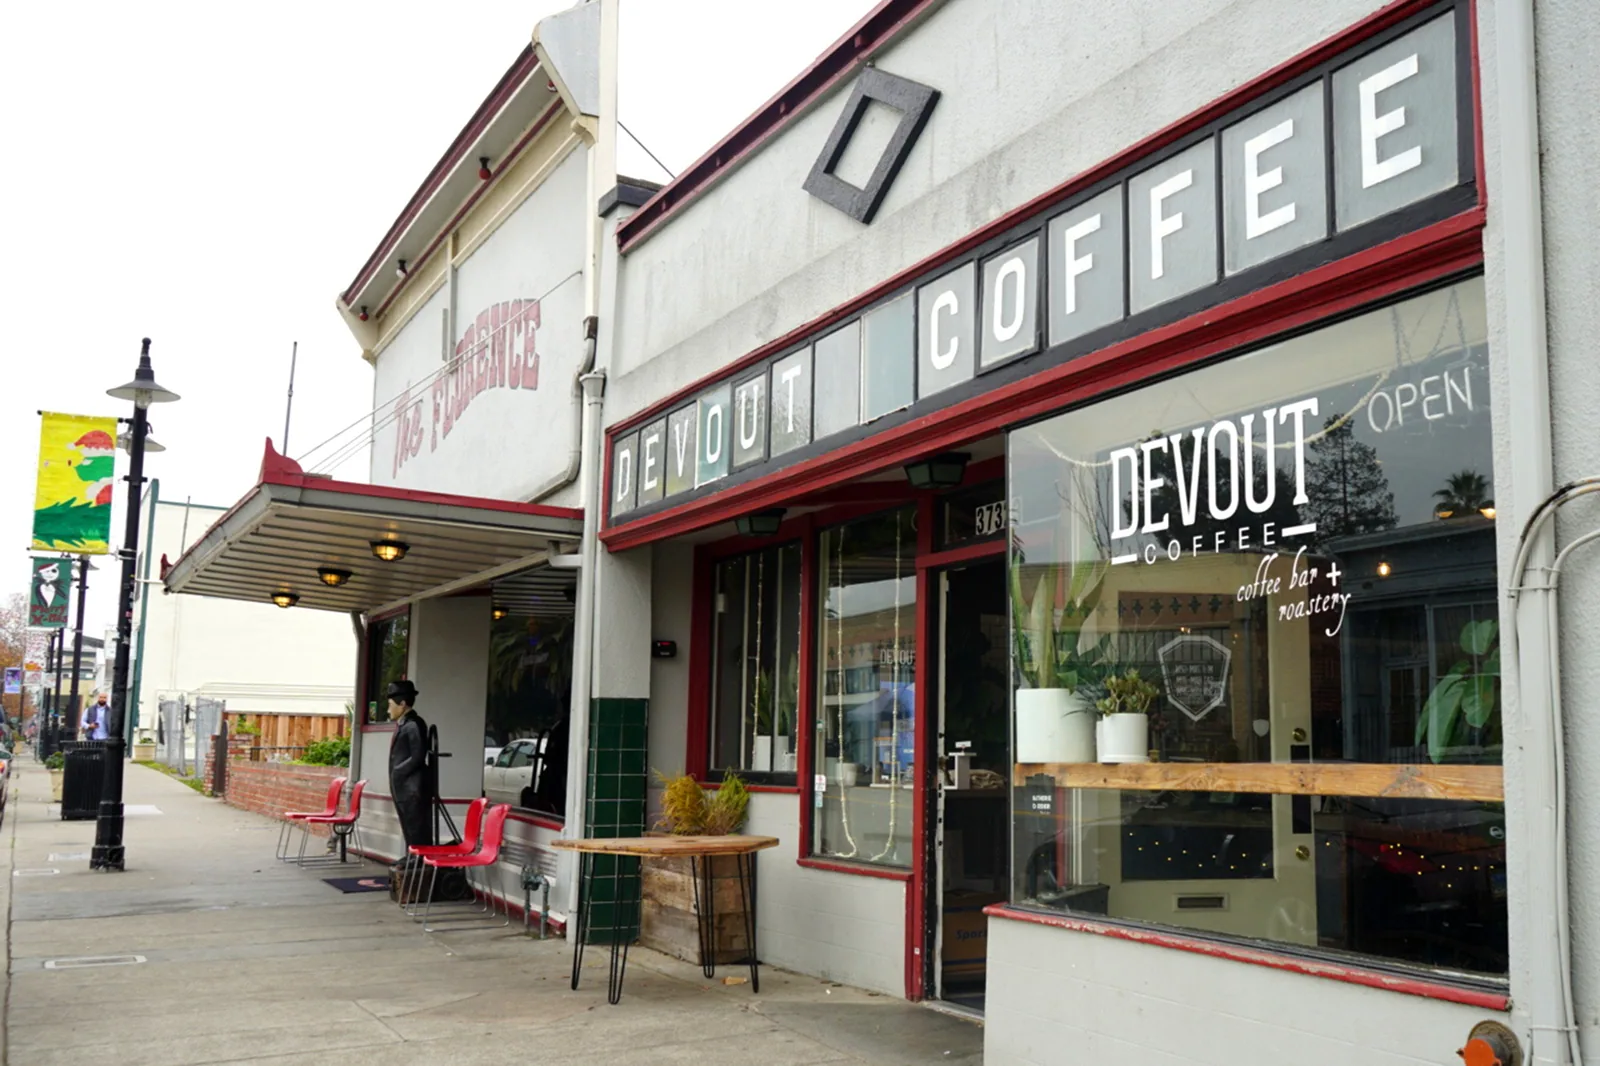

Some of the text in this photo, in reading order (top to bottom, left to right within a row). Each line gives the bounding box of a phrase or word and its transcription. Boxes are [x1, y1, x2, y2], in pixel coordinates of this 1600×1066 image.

[617, 53, 1422, 502] DEVOUT COFFEE
[431, 298, 541, 453] FLORENCE
[1368, 367, 1473, 432] OPEN
[1111, 397, 1318, 540] DEVOUT
[1144, 522, 1275, 565] COFFEE
[1237, 552, 1280, 602] coffee
[1289, 546, 1317, 591] bar
[1279, 591, 1351, 637] roastery
